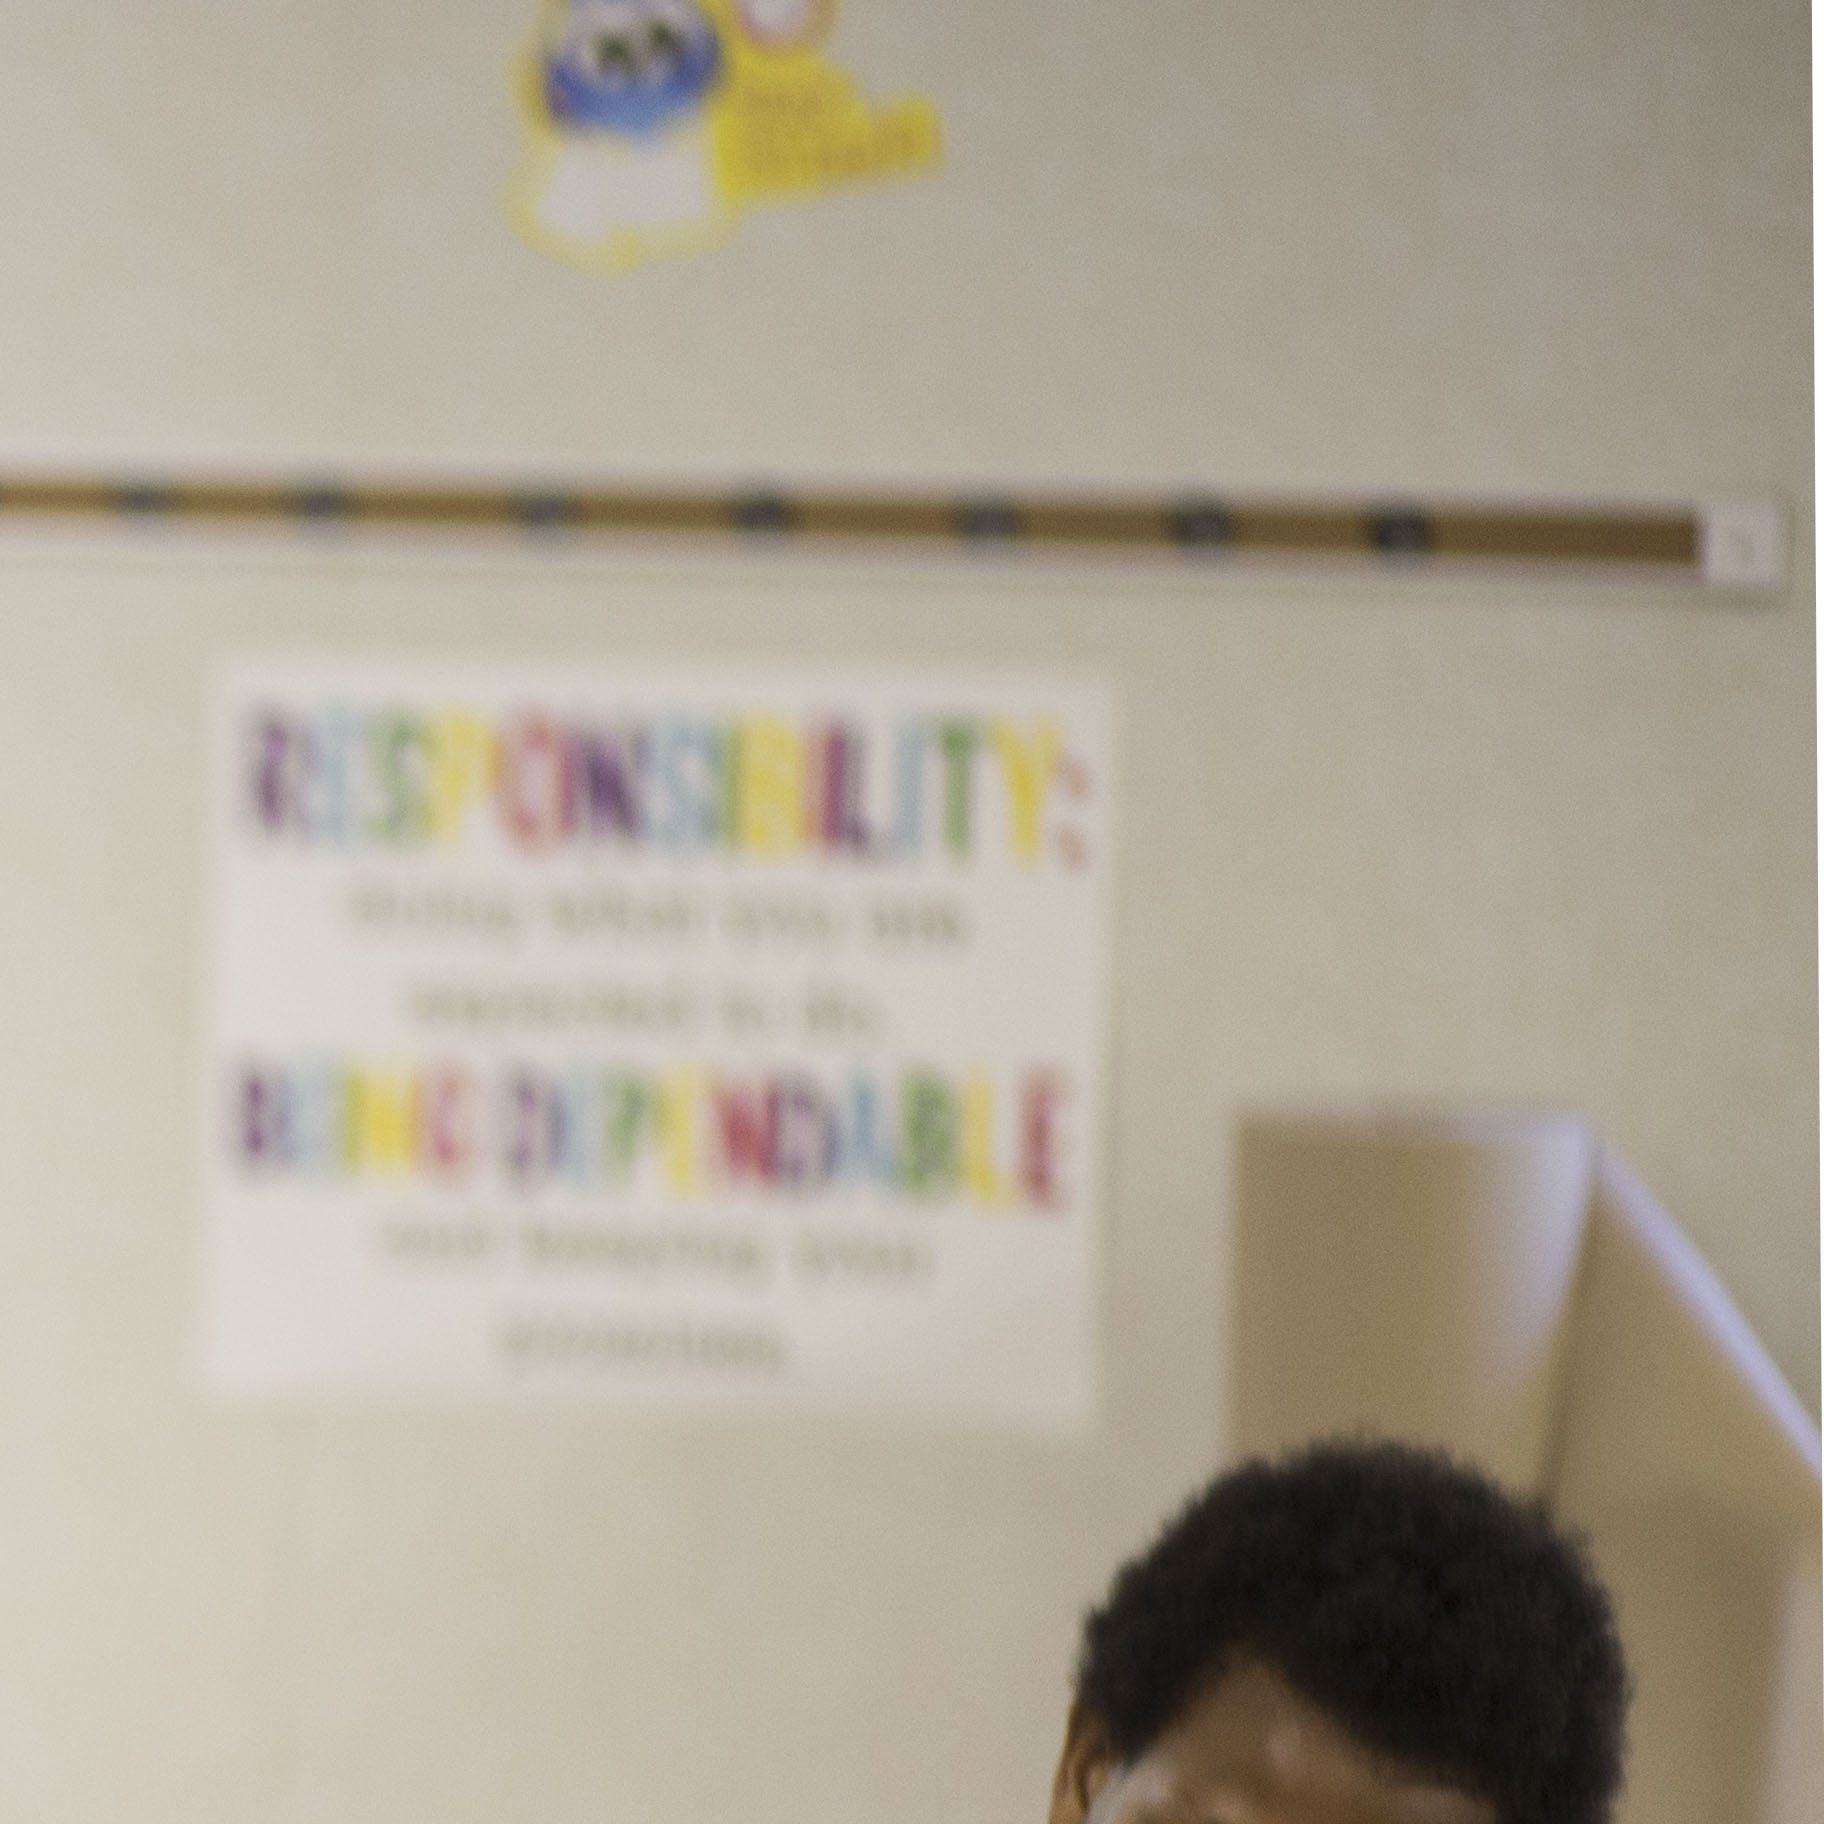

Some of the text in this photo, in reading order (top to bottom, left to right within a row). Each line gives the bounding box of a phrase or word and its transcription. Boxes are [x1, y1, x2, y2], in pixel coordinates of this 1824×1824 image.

[244, 706, 1094, 870] RESPONSIBILITY:
[236, 1055, 1074, 1214] BEING DEPENDABLE
